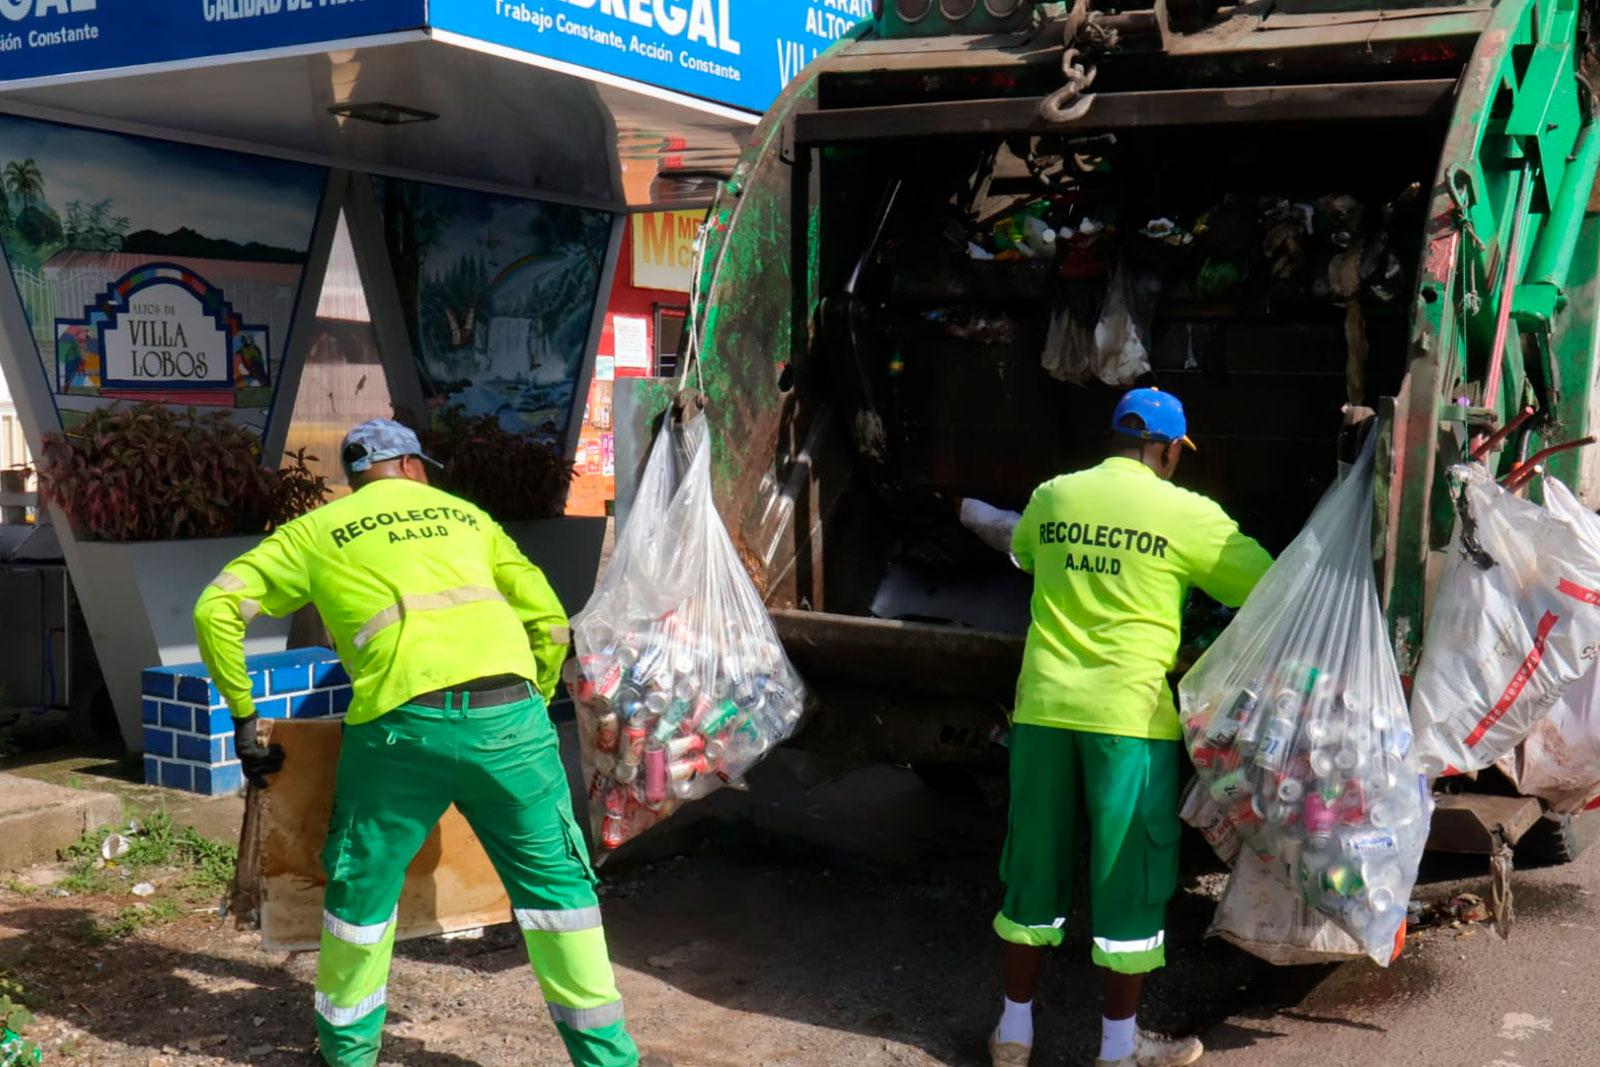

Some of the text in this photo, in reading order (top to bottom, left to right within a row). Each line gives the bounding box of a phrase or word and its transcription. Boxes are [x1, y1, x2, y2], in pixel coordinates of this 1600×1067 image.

[0, 23, 99, 52] ión Constante
[495, 0, 741, 82] Trabajo Constante, Acción Constante
[128, 320, 188, 348] VILLA
[131, 350, 208, 379] LOBOS
[331, 507, 480, 549] RECOLECTOR
[1039, 521, 1169, 559] RECOLECTOR
[1064, 553, 1122, 576] A.A.U.D
